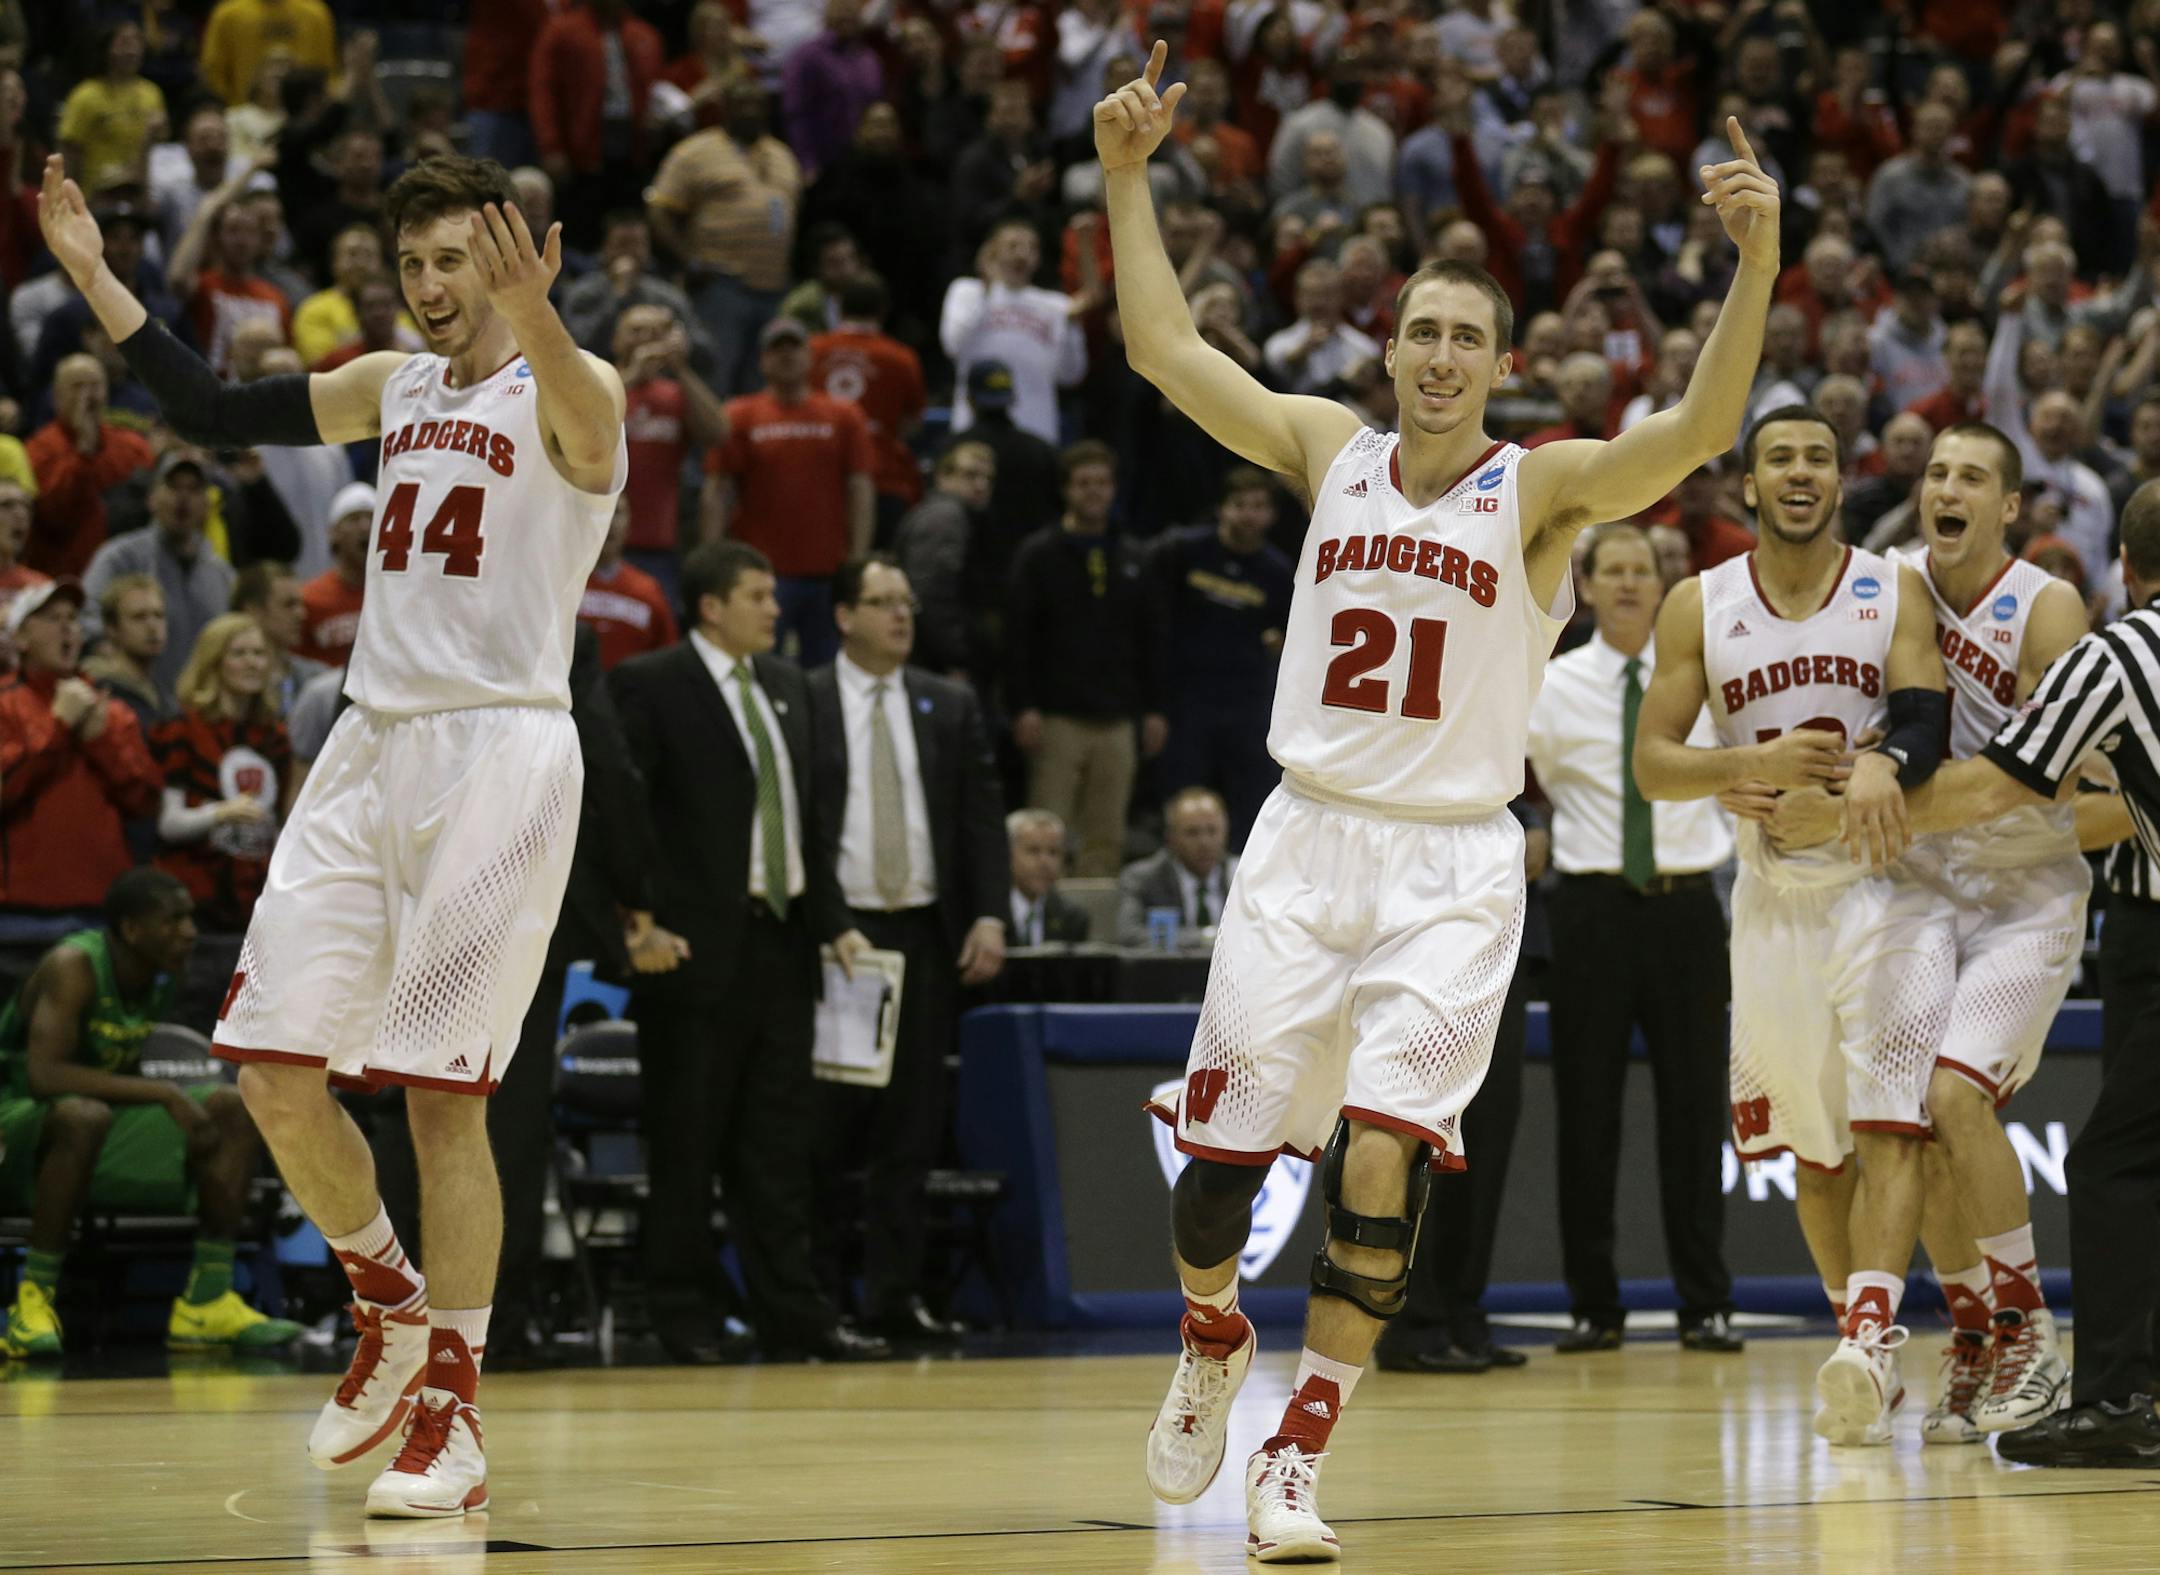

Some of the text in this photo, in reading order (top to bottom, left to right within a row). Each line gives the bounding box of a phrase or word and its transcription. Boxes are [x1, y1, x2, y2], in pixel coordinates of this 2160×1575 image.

[383, 420, 515, 477] BADGERS
[376, 482, 486, 578] 44
[1315, 534, 1499, 608] BADGERS
[1321, 607, 1448, 721] 21
[1722, 655, 1880, 714] BADGERS
